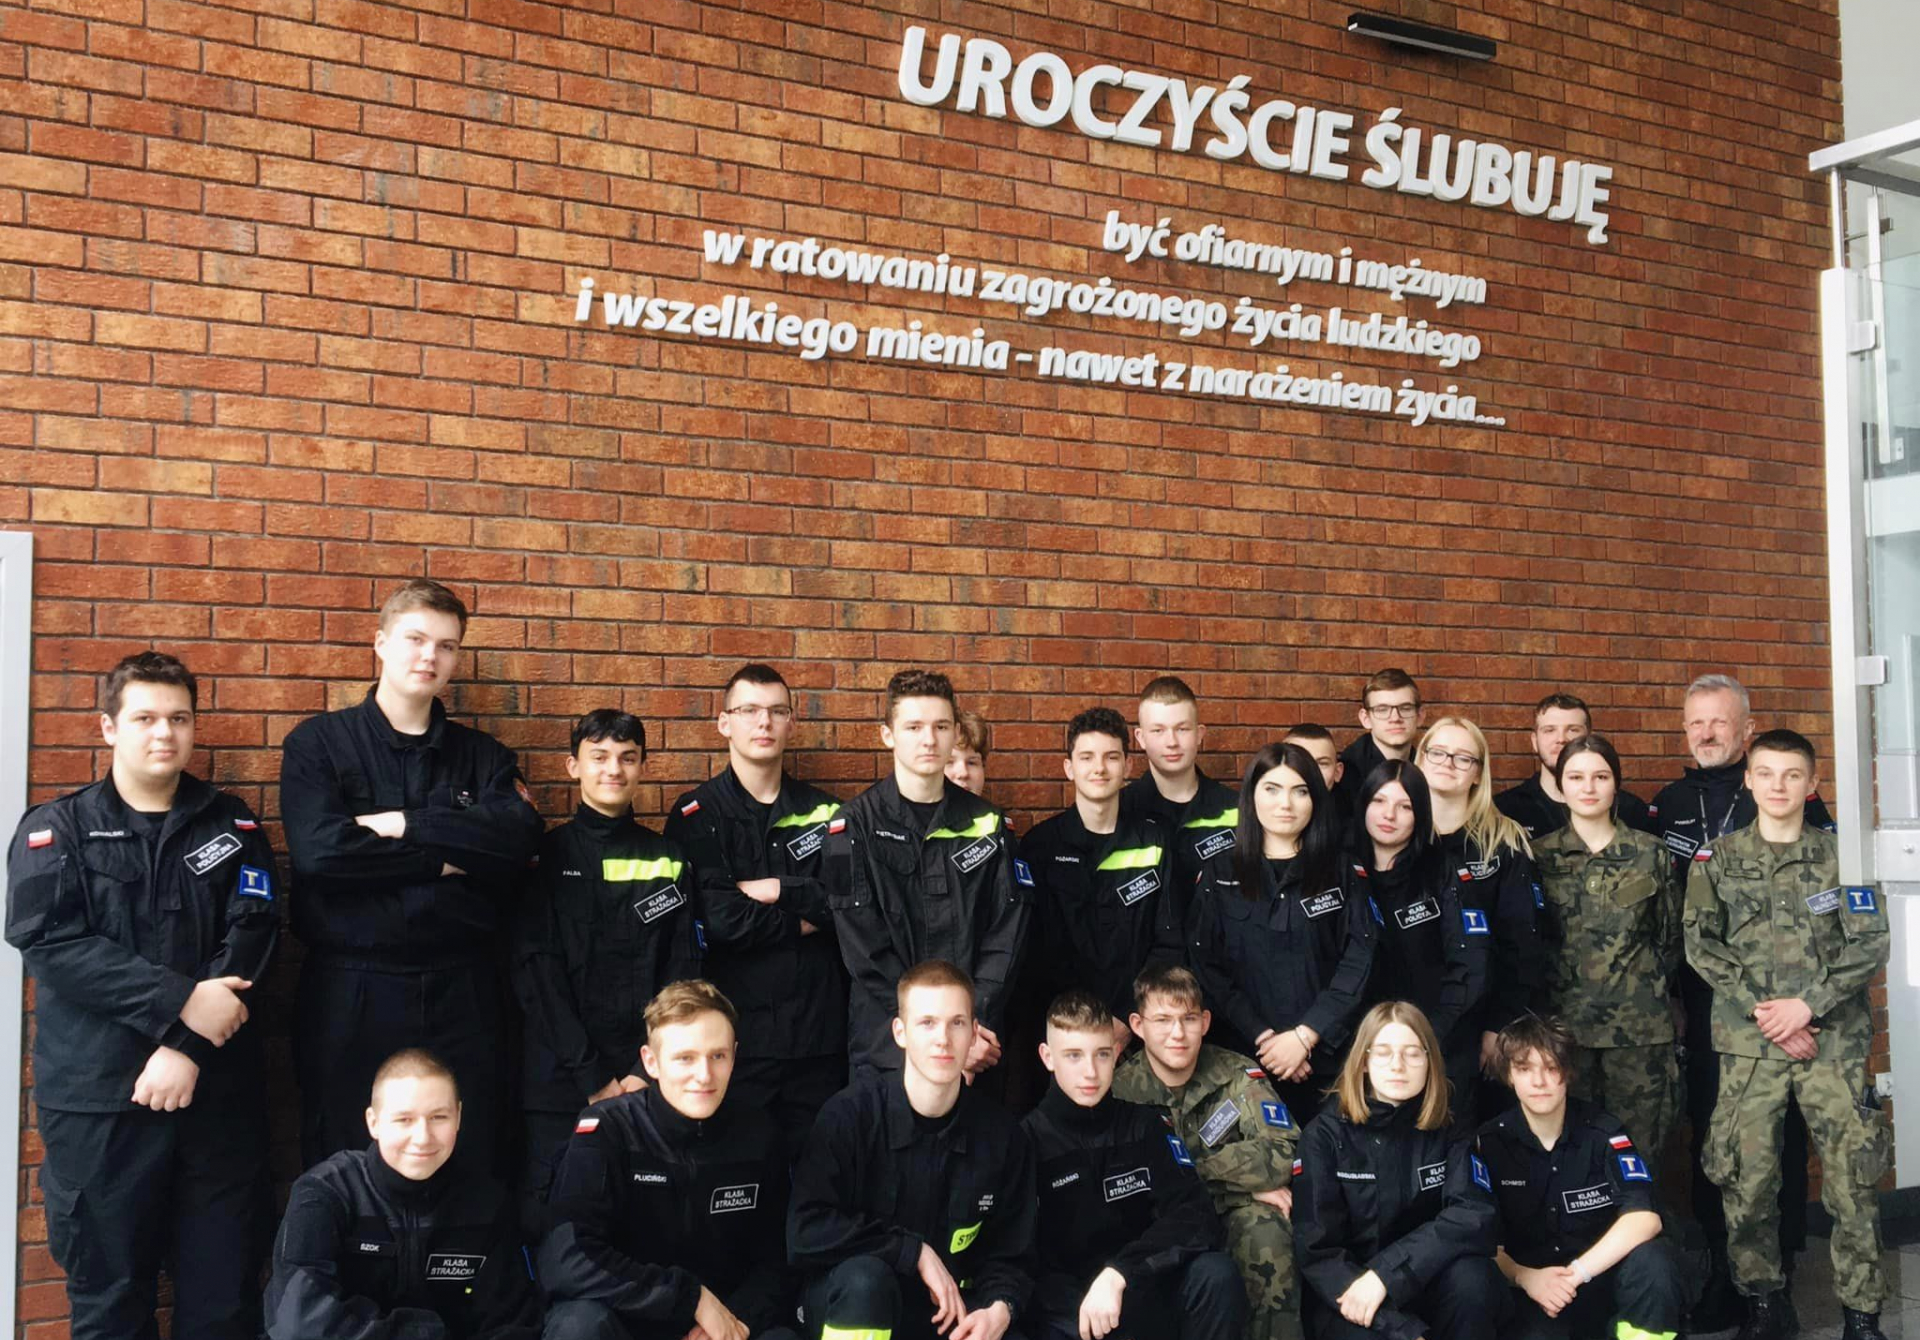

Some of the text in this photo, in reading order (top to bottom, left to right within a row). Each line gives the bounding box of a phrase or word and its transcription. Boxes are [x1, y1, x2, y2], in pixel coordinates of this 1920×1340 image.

[898, 26, 1613, 244] UROCZYŚCIE ŚLUBUJĘ
[1103, 210, 1487, 309] być ofiarnym i mężnym
[703, 230, 1481, 368] w ratowaniu zagrożonego życia ludzkiego
[575, 277, 594, 321] i
[603, 292, 858, 360] wszelkiego
[866, 320, 1010, 370] mienia
[1038, 346, 1159, 387] nawet
[1161, 362, 1186, 390] z
[1189, 365, 1392, 412] narażeniem
[197, 843, 221, 860] KLASA
[724, 1189, 745, 1199] KLASA
[1577, 1191, 1601, 1201] KLASA
[430, 1266, 476, 1276] STRAŻACKA
[442, 1259, 468, 1267] KLASA
